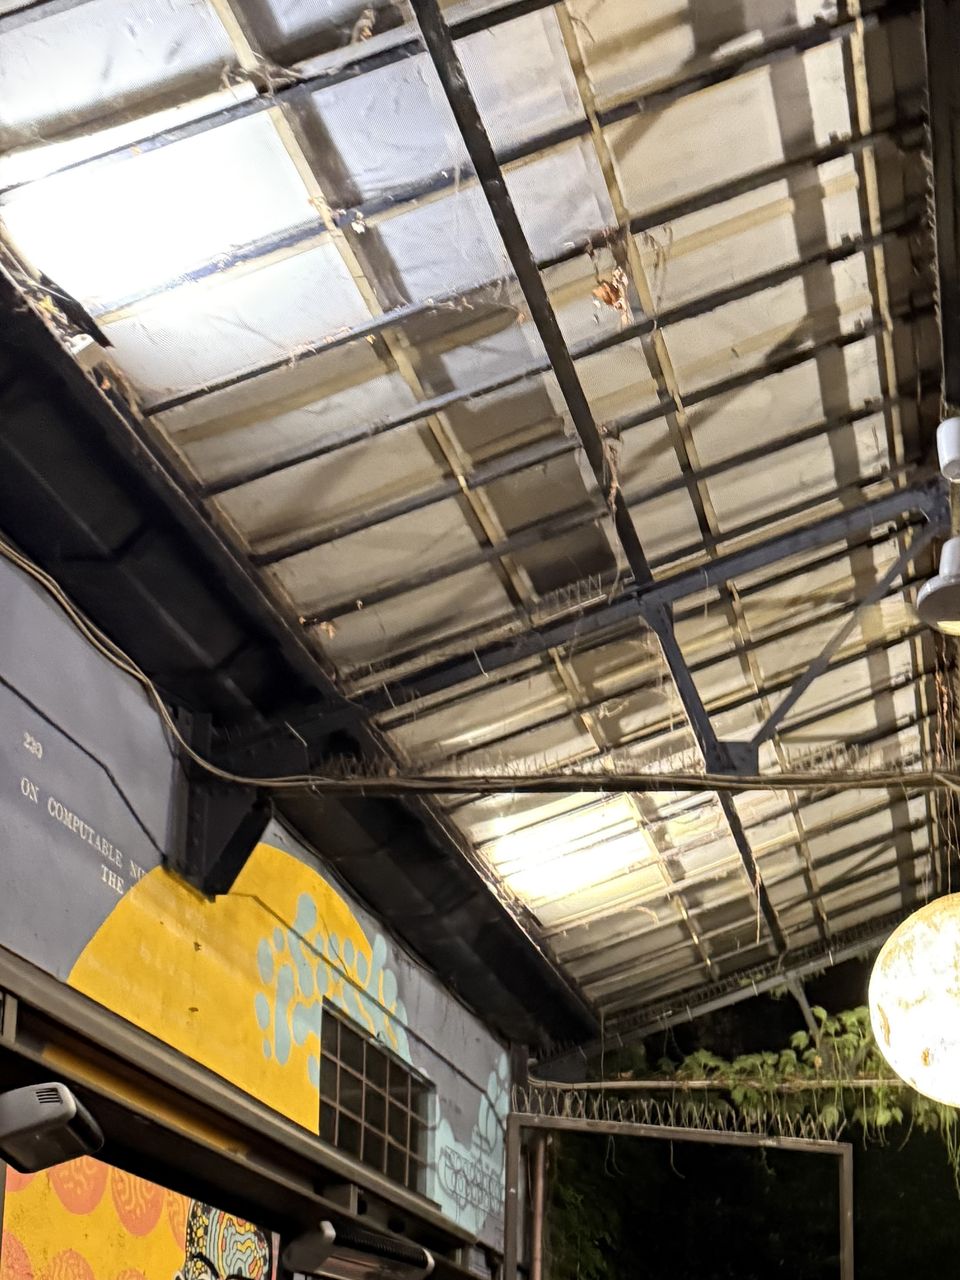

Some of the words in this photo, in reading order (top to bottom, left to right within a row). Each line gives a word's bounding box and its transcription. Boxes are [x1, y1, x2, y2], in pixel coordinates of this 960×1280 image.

[21, 777, 39, 803] ON
[48, 796, 123, 869] COMPUTABLE
[101, 864, 124, 895] THE
